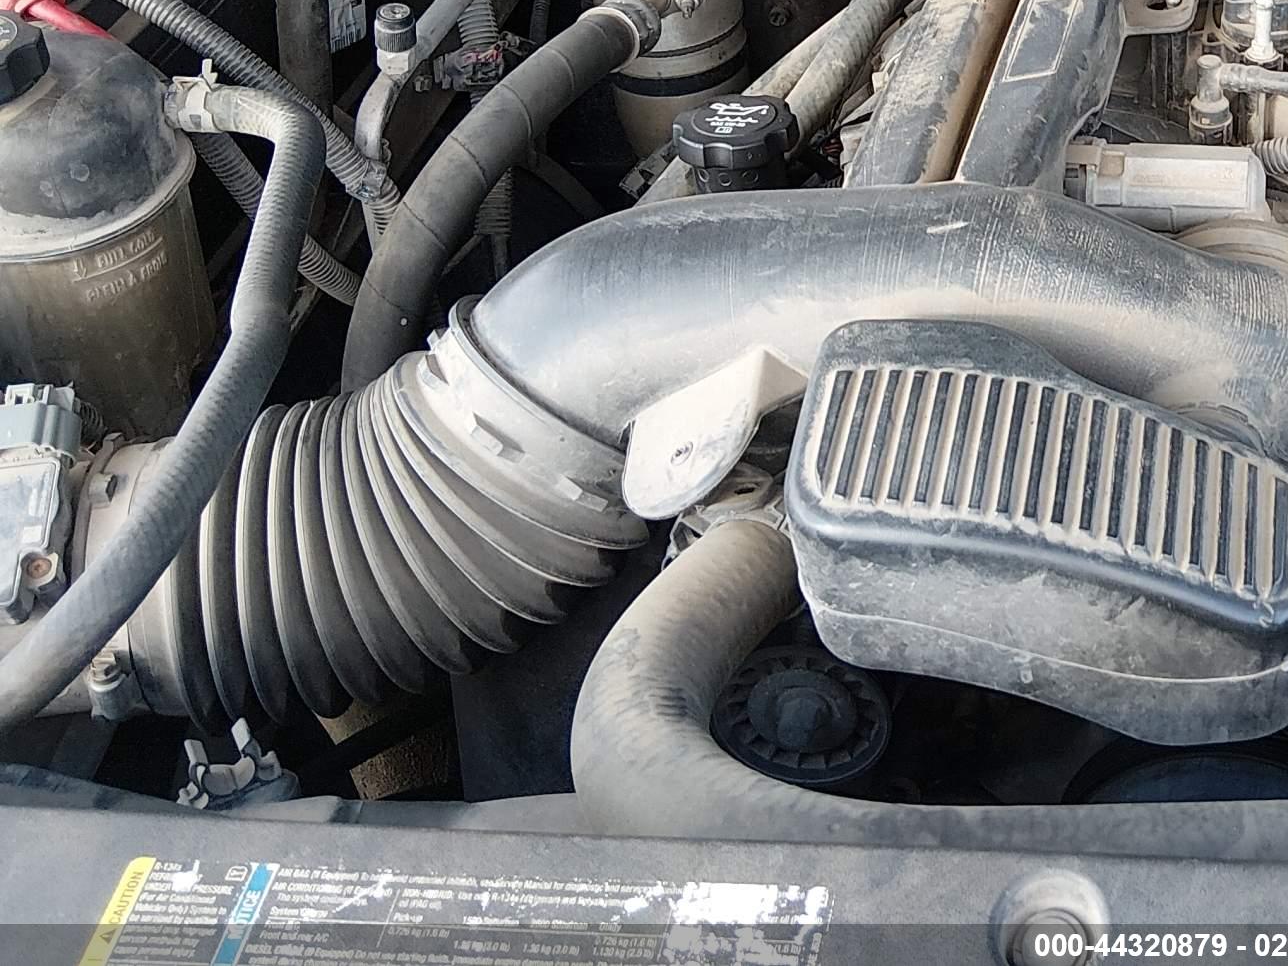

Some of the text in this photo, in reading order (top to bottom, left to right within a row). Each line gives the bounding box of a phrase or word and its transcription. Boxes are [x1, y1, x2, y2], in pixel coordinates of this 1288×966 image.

[278, 868, 293, 876] AIR
[293, 869, 310, 878] BAG
[320, 870, 359, 882] Equipped)
[144, 882, 172, 892] UNDER
[192, 884, 235, 895] PRESSURE
[272, 883, 287, 891] AIR
[287, 883, 343, 895] CONDITIONING
[109, 871, 145, 925] CAUTION
[155, 893, 169, 902] Air
[169, 894, 217, 905] Conditioned
[269, 906, 299, 916] System
[260, 930, 281, 939] Front
[244, 944, 273, 954] DIESEL
